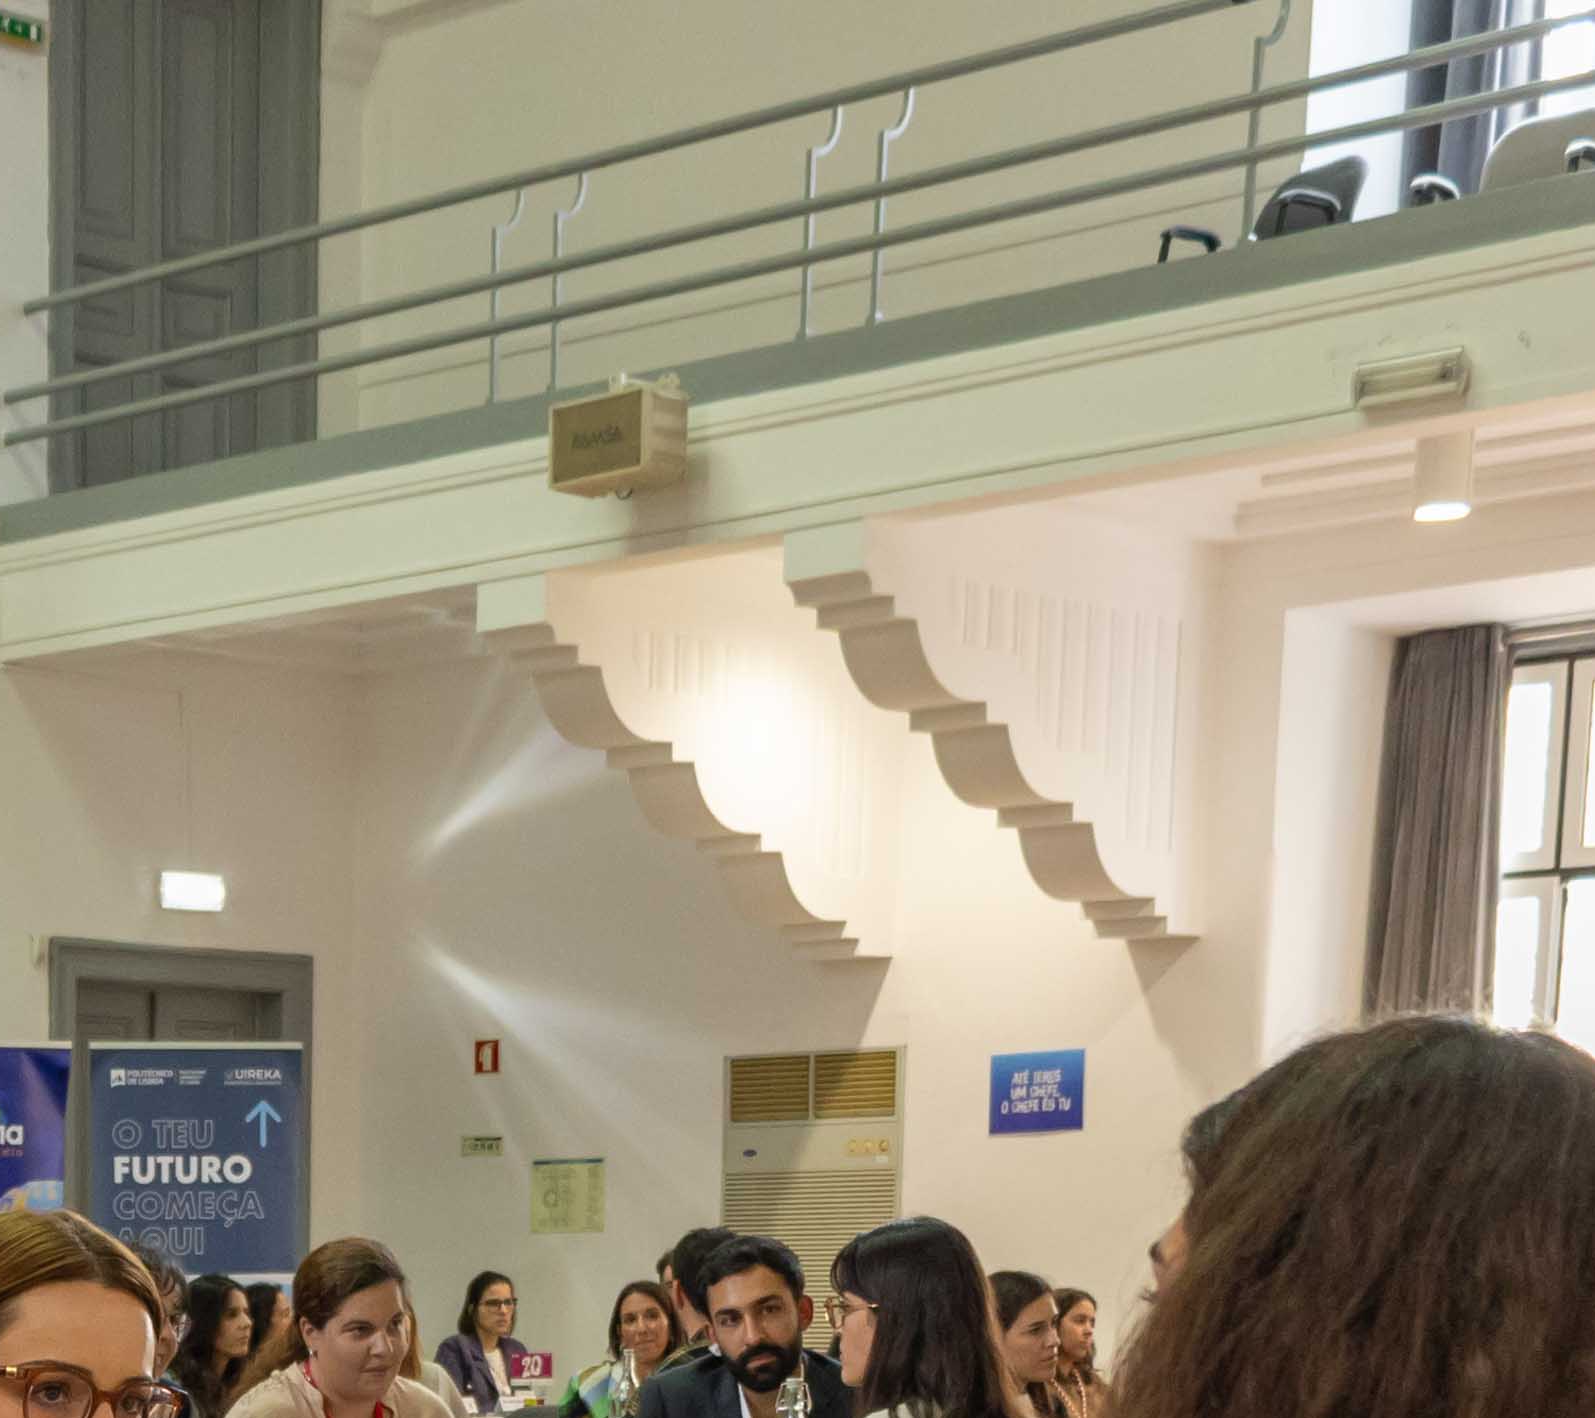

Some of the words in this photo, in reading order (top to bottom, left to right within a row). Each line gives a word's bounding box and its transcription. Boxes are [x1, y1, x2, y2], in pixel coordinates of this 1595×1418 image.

[1011, 1068, 1029, 1085] ATÉ
[1010, 1086, 1027, 1100] UM
[1001, 1100, 1009, 1114] O
[1058, 1096, 1071, 1111] TU
[112, 1119, 141, 1149] O
[152, 1119, 213, 1149] TEU
[113, 1155, 252, 1184] FUTURO
[112, 1190, 264, 1228] COMEÇA
